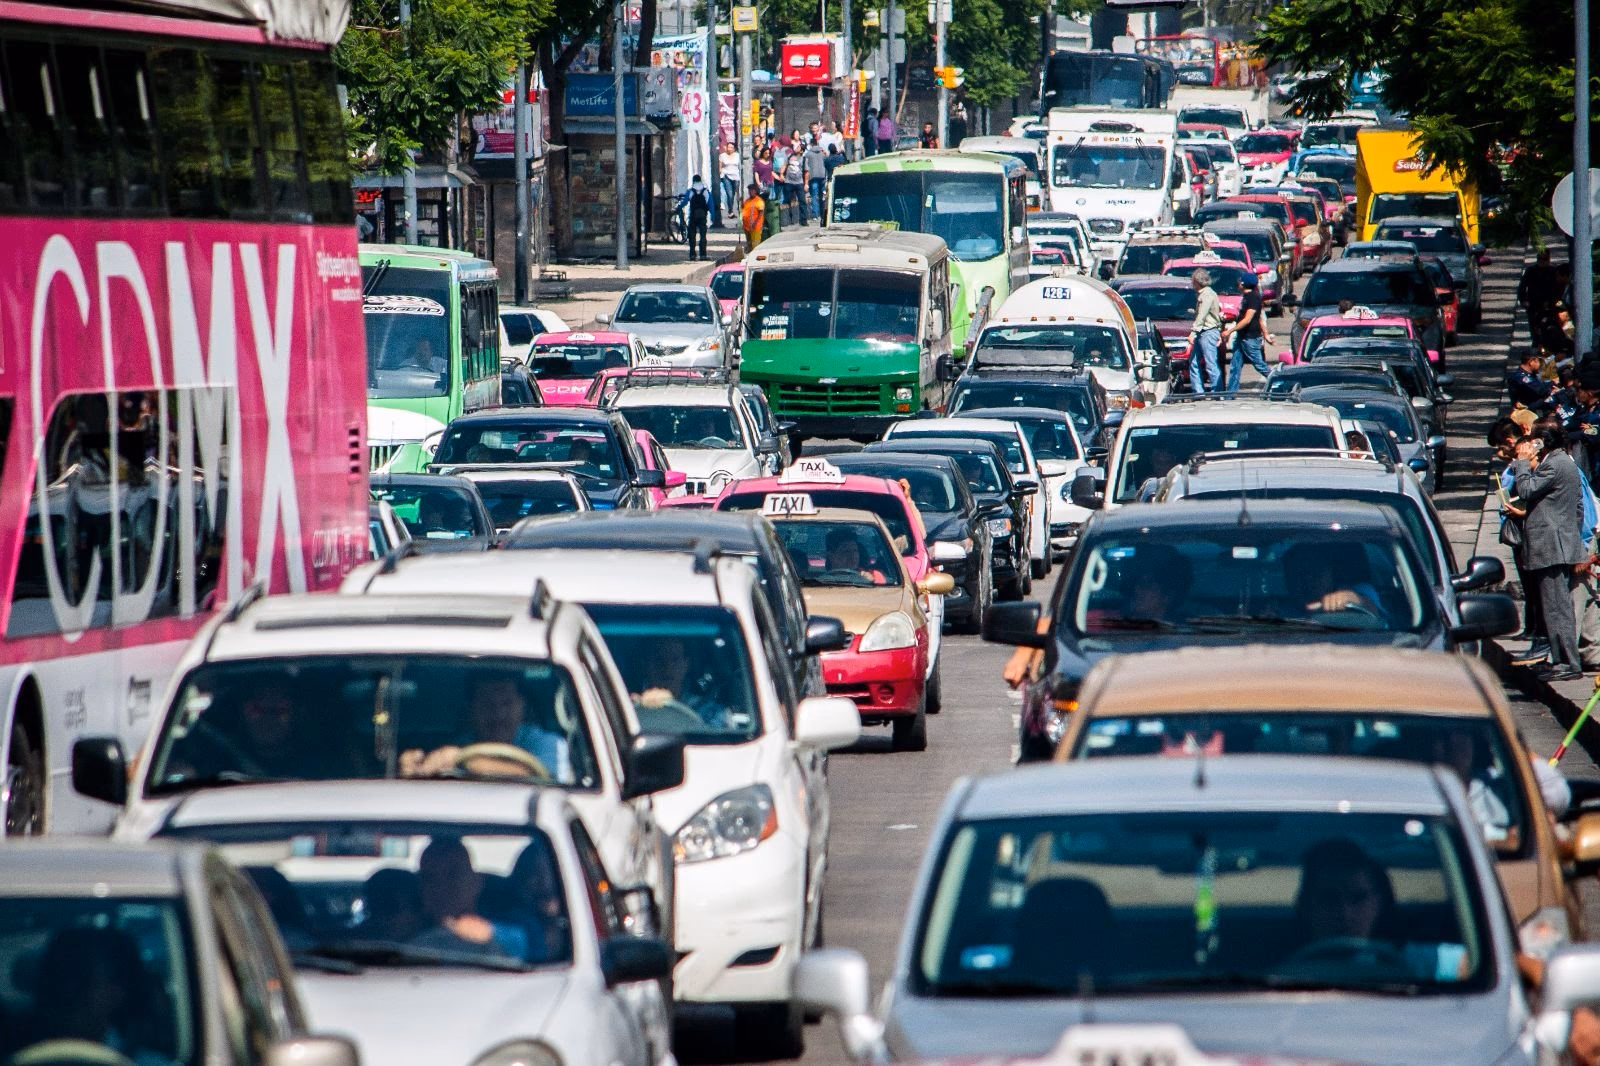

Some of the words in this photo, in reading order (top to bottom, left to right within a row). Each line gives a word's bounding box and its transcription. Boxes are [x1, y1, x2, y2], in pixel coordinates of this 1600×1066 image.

[570, 96, 608, 105] MetLife
[681, 92, 702, 123] 43
[1043, 287, 1070, 299] 428-1
[31, 234, 307, 641] CDMX
[800, 462, 825, 472] TAXI
[771, 496, 805, 512] TAXI
